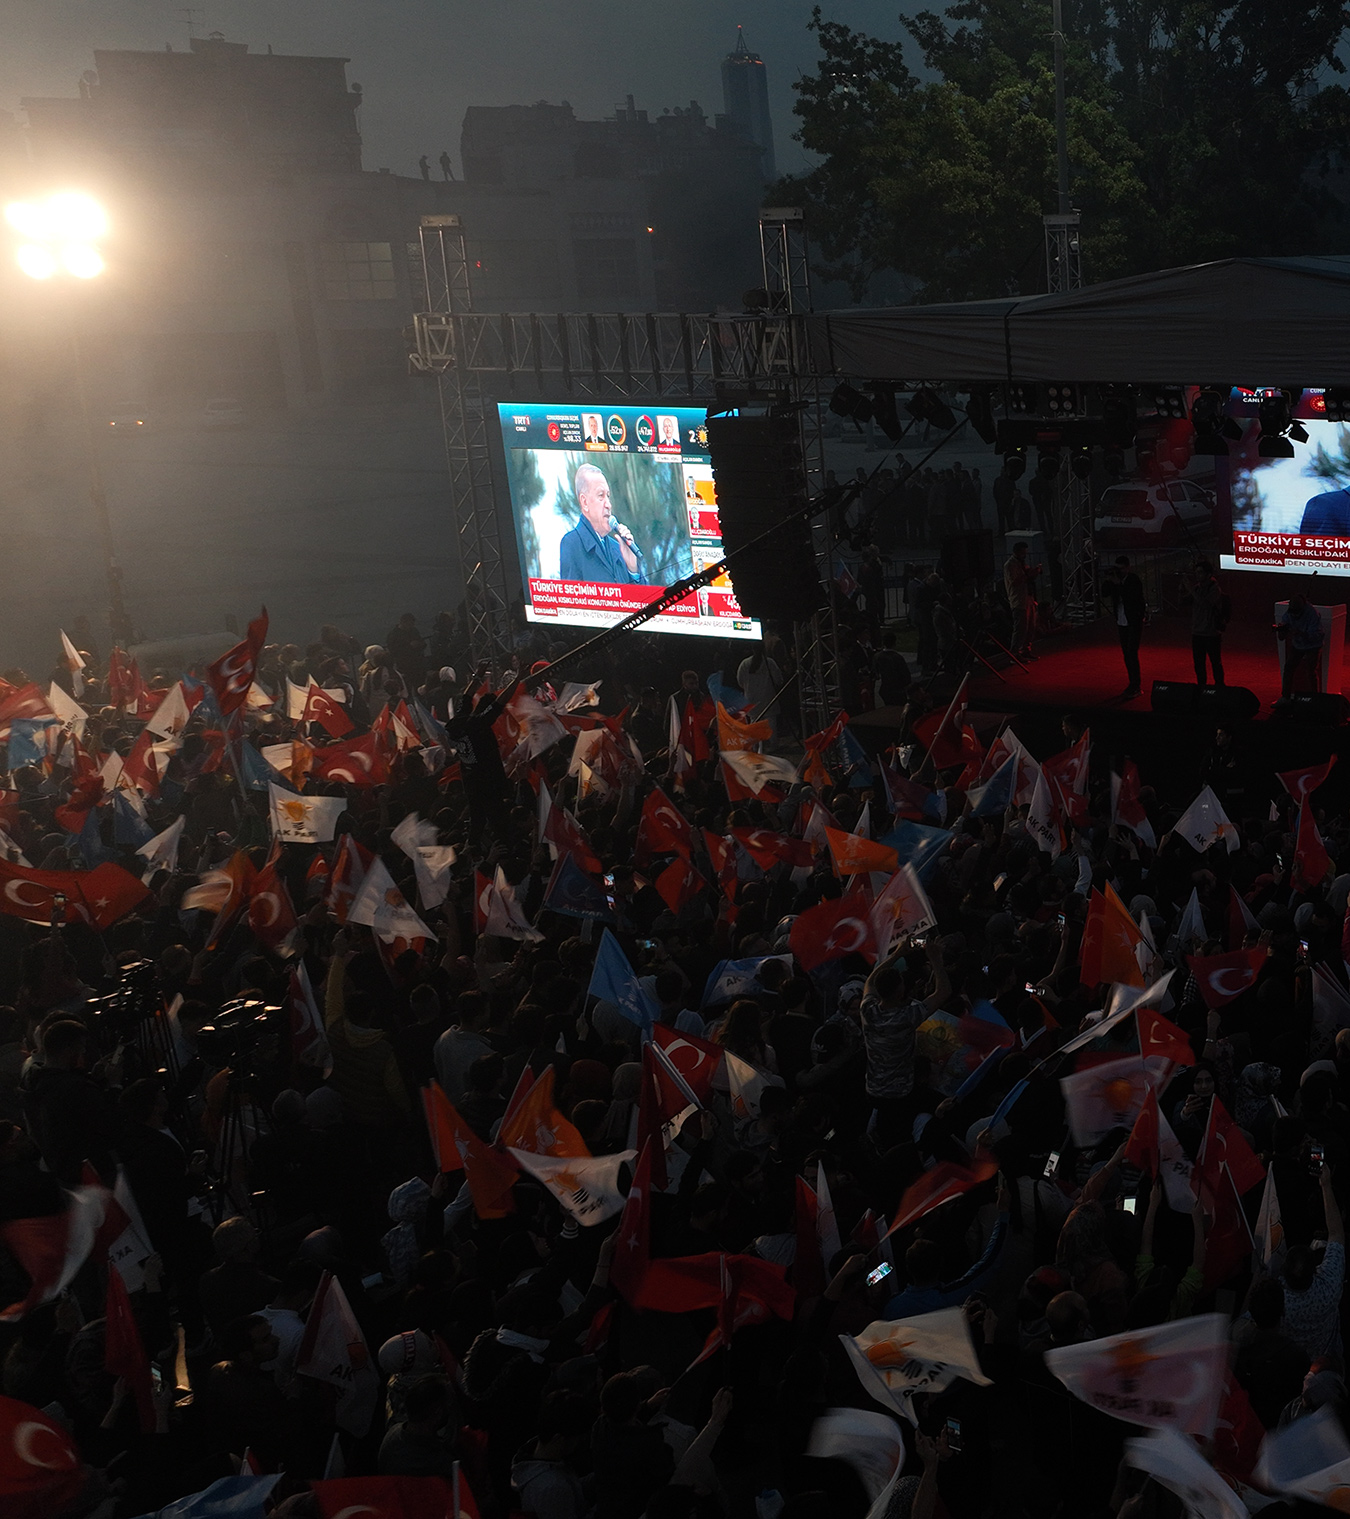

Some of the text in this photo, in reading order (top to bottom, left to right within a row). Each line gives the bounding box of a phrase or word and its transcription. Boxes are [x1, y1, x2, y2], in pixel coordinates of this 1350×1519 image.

[1238, 534, 1301, 547] TÜRKİYE
[1238, 546, 1288, 556] ERDOĞAN,
[1289, 549, 1349, 558] KISIKLI'DAKİ
[1308, 561, 1341, 569] DOLAYI
[531, 580, 622, 598] TÜRKİYE SEÇİMİNİ YAPTI
[676, 604, 696, 613] EDİYOR
[1028, 815, 1039, 828] AK
[1193, 833, 1205, 846] AK
[330, 1364, 353, 1382] AK
